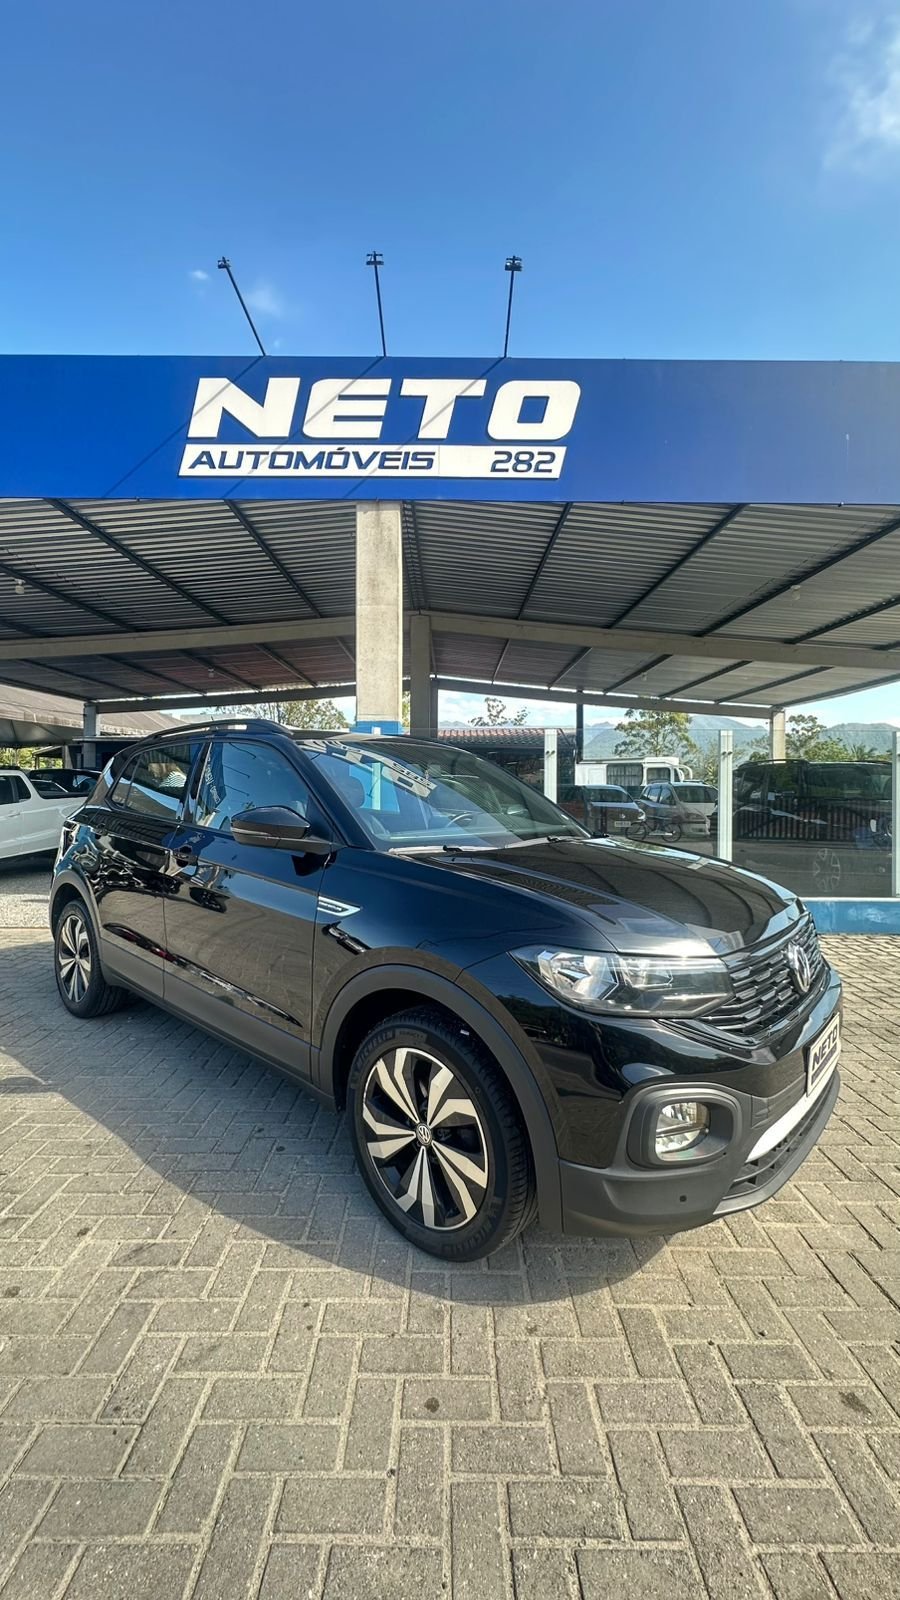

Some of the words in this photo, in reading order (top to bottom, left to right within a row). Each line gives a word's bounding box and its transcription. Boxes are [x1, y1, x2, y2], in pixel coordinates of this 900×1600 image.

[188, 377, 581, 441] NETO
[188, 447, 434, 471] AUTOMÓVEIS
[490, 451, 556, 473] 282
[811, 1023, 838, 1072] NETO
